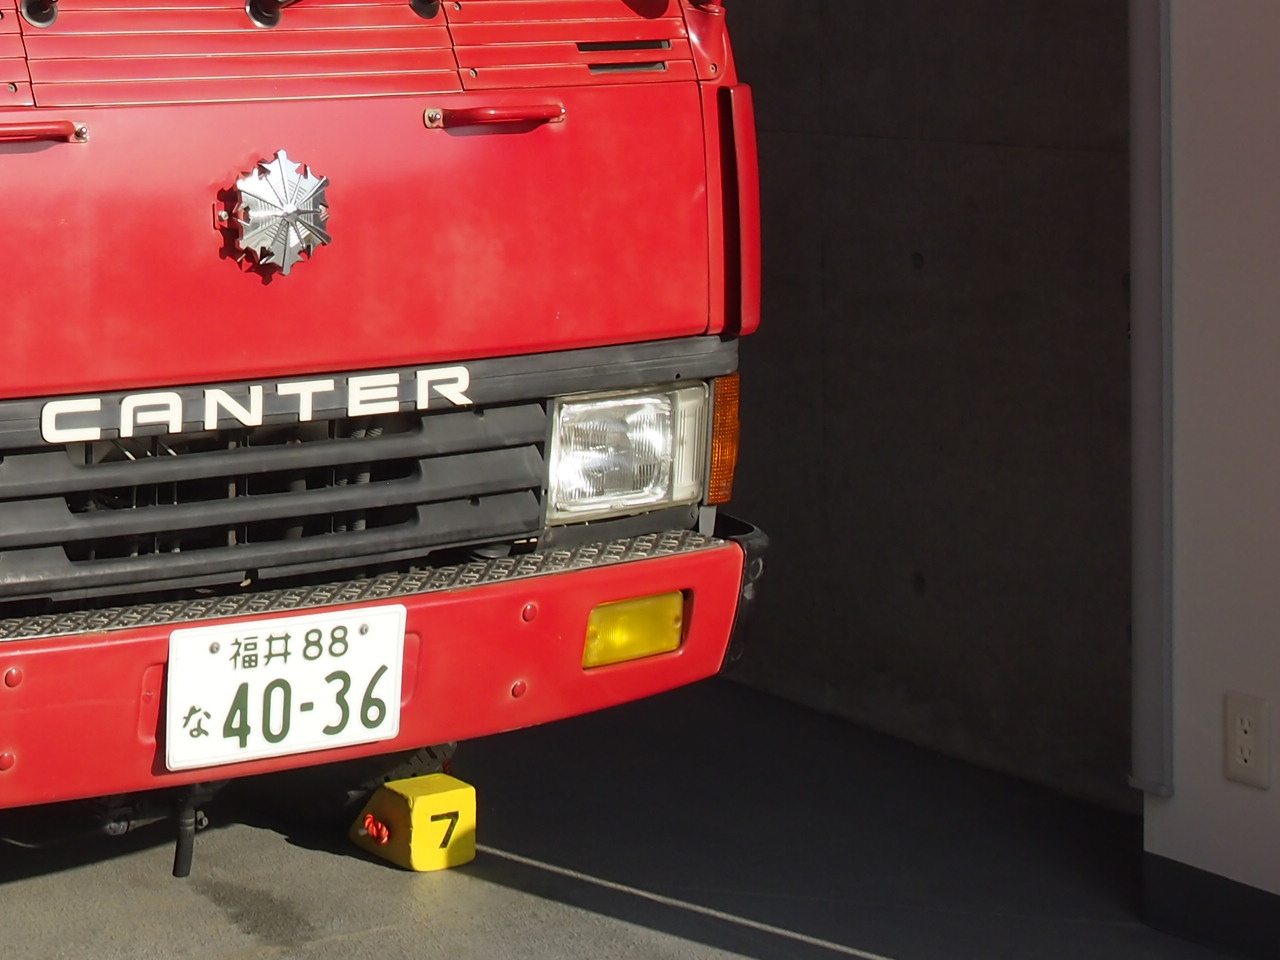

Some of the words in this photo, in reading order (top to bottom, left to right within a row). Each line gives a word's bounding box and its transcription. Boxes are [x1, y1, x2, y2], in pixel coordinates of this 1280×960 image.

[41, 366, 473, 443] CANTER
[182, 705, 212, 739] な
[222, 664, 389, 749] 40-36
[430, 811, 460, 849] 7
